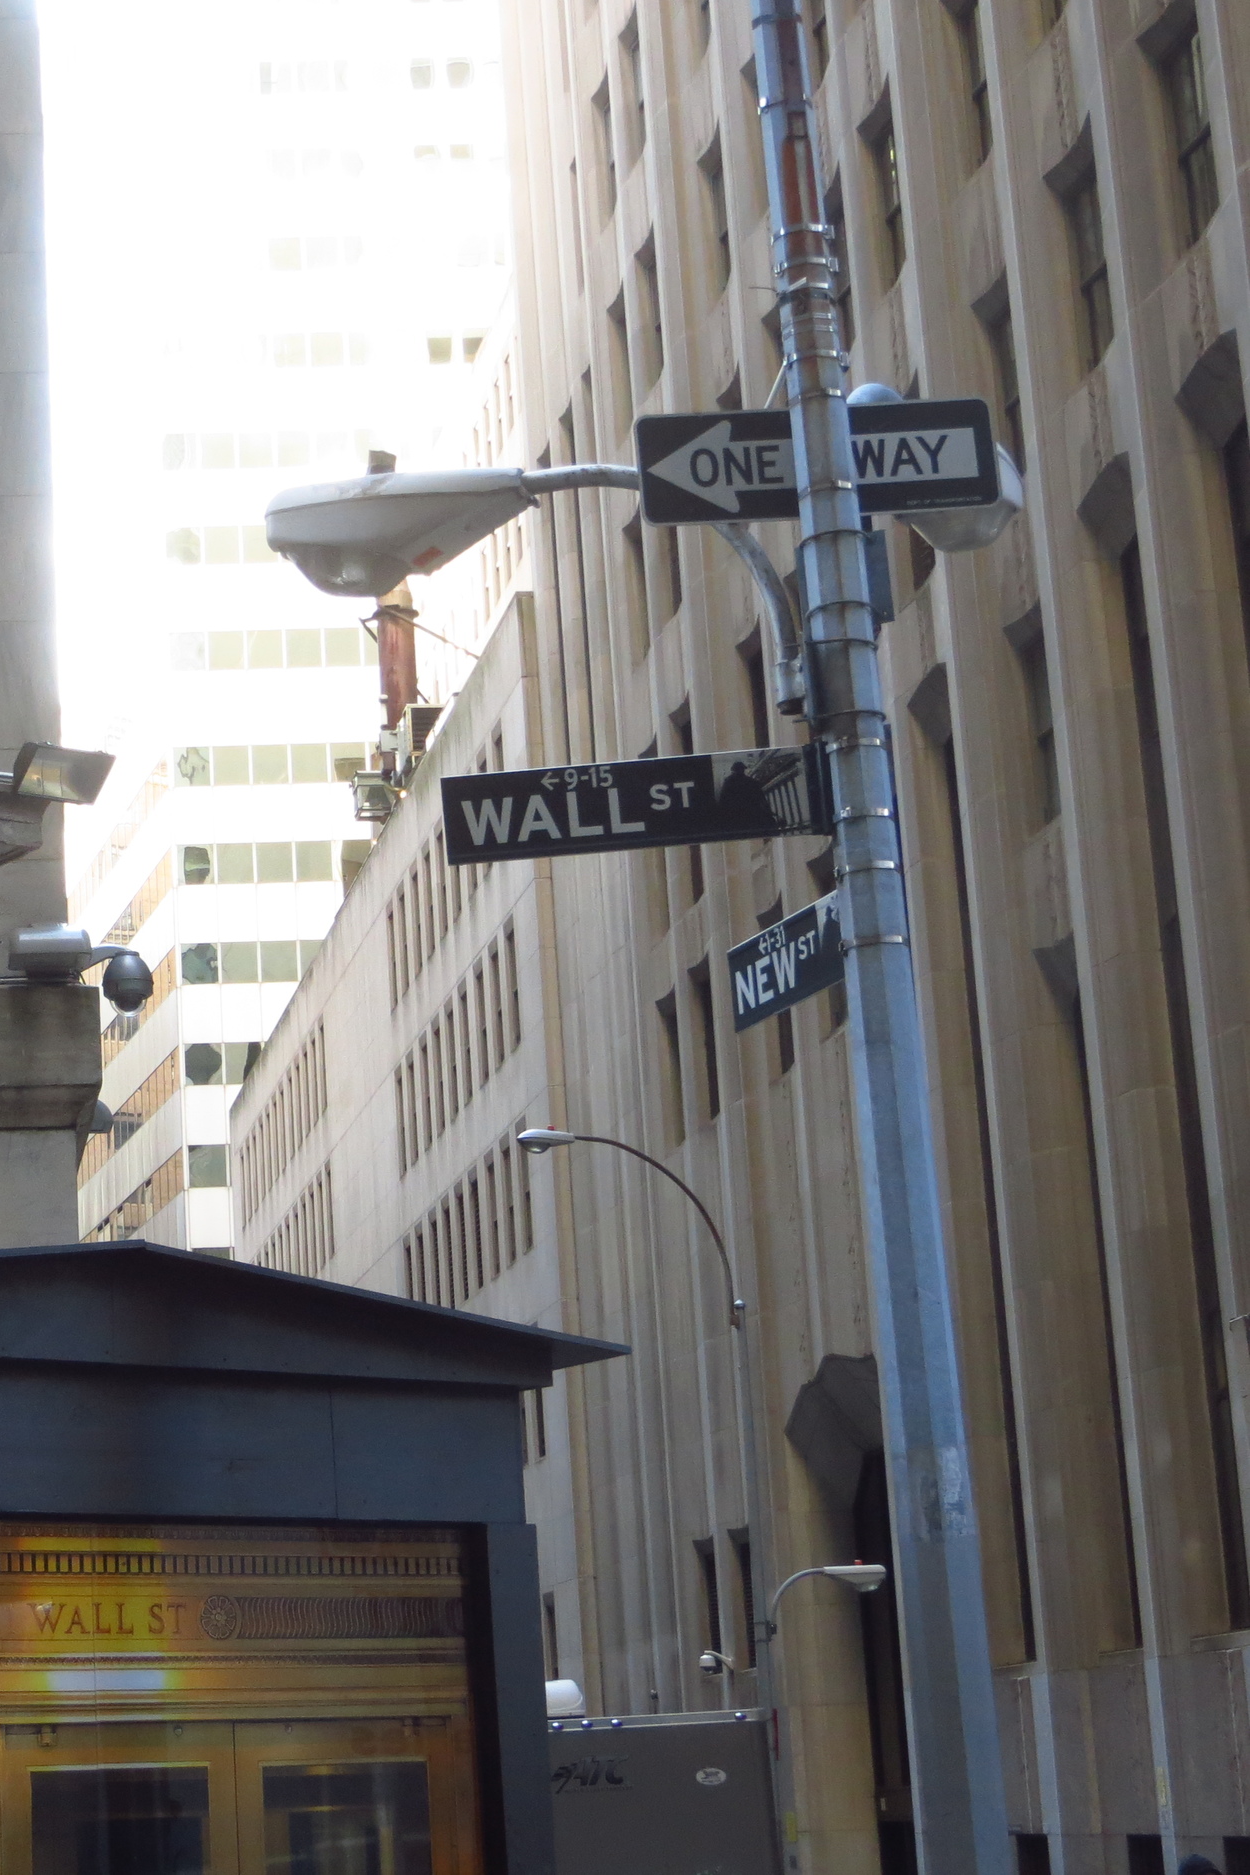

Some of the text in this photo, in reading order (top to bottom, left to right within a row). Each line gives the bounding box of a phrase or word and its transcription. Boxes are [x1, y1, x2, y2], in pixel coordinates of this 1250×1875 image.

[689, 435, 948, 488] ONE WAY
[563, 765, 613, 789] 9-15
[461, 781, 695, 847] WALL ST
[735, 930, 816, 1015] NEW ST
[27, 1602, 134, 1636] WALL
[148, 1603, 186, 1635] ST
